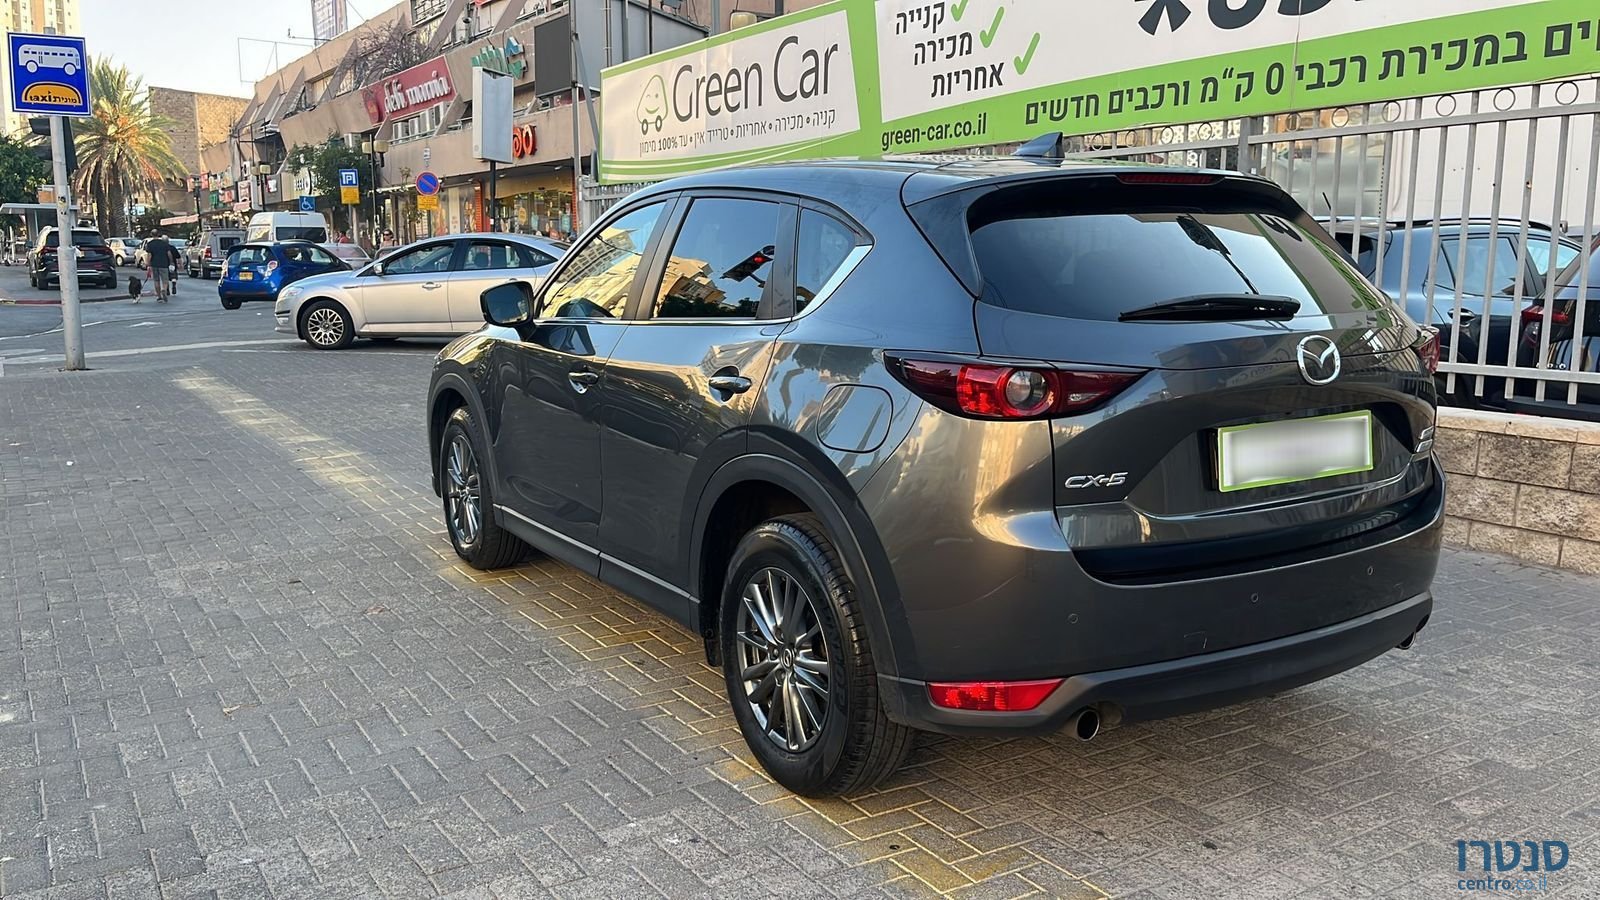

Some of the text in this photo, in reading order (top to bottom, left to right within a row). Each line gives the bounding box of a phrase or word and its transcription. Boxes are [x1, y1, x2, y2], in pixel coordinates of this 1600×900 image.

[896, 2, 945, 35] קנייה
[914, 31, 973, 65] מכירה
[1378, 30, 1527, 80] במכירת
[1544, 19, 1600, 57] ים
[673, 35, 838, 122] Green Car
[931, 62, 1004, 97] אחריות
[1265, 62, 1284, 95] 0
[1295, 55, 1367, 90] רכבי
[29, 91, 51, 102] taxi
[53, 96, 77, 104] מונית
[1025, 94, 1099, 124] חדשים
[1108, 80, 1190, 114] ורכבים
[639, 109, 835, 158] קניה מכירה אחריות טרייד אין עד 100% מימון
[881, 112, 987, 151] green-car.co.il
[1064, 472, 1128, 489] CX-5
